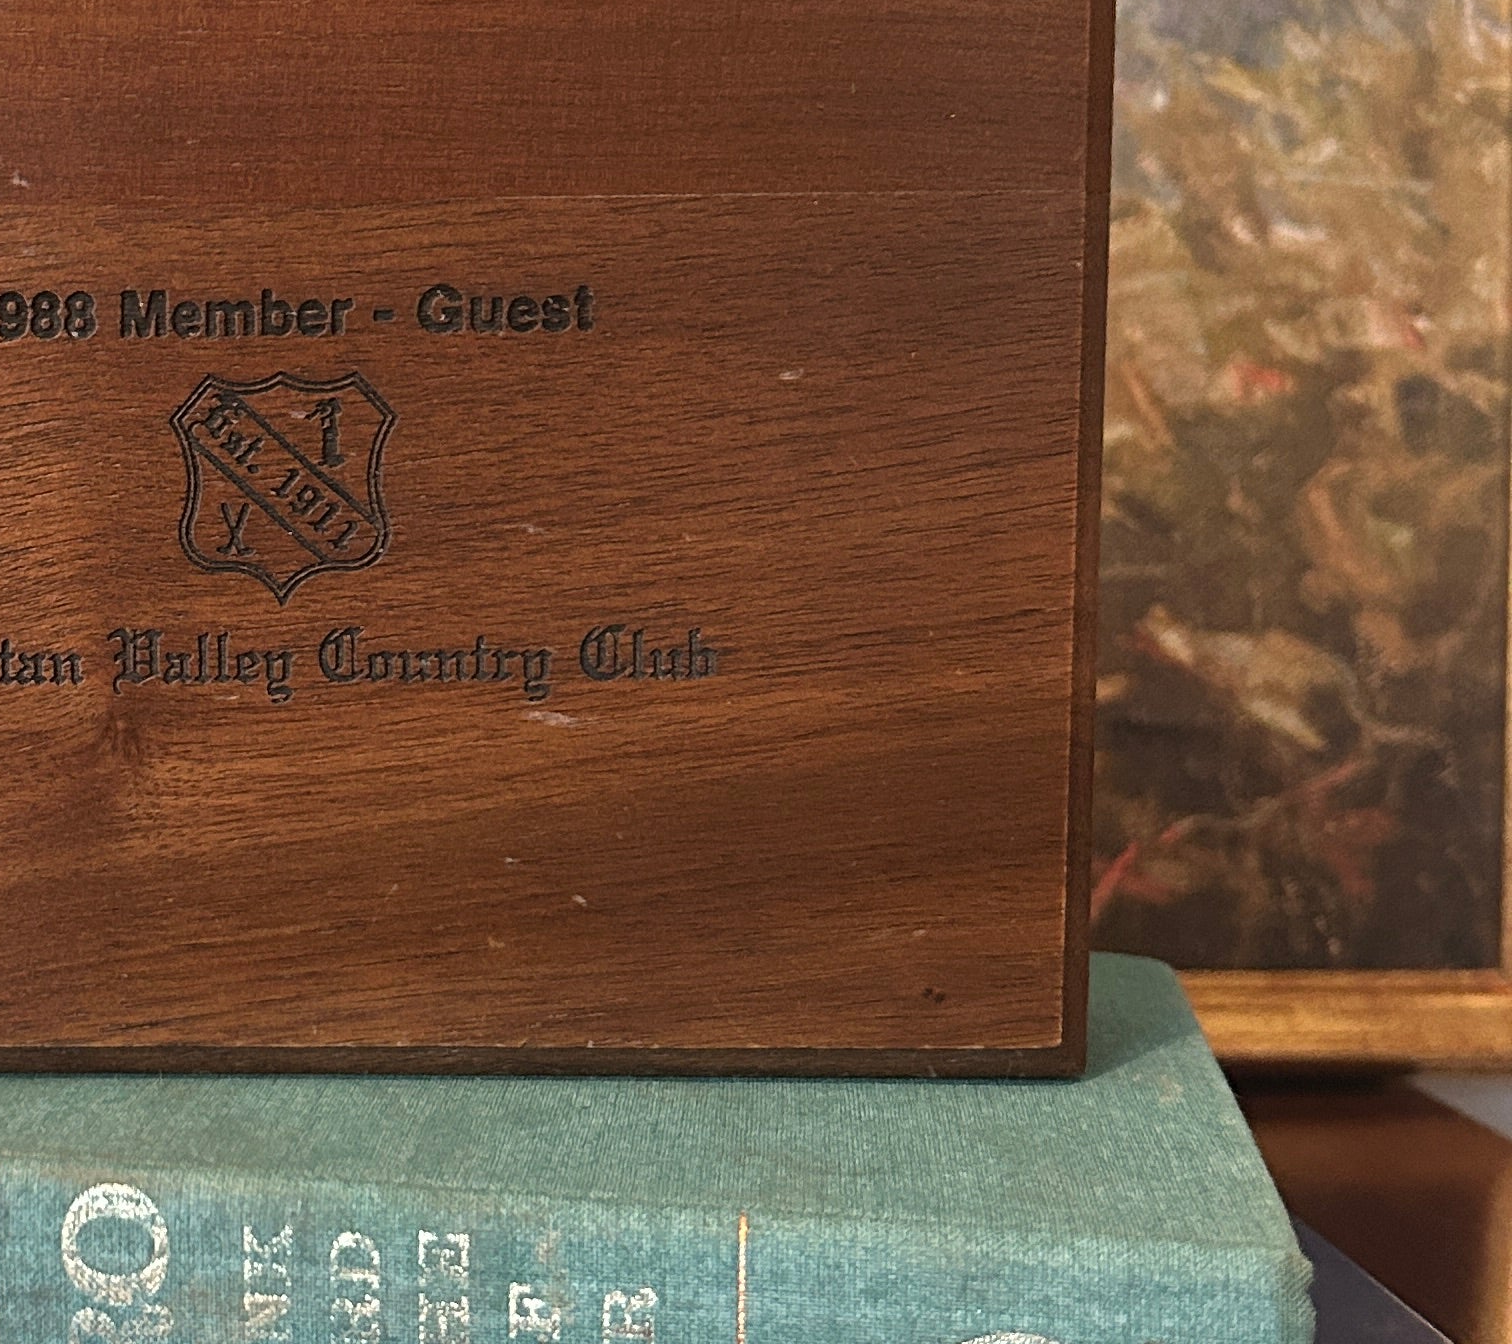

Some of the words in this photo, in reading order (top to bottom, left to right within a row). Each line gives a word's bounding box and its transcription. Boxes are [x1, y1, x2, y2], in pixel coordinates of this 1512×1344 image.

[119, 288, 354, 340] Member
[417, 283, 594, 334] Guest
[108, 627, 295, 703] Valley
[319, 627, 552, 702] Country
[579, 624, 721, 683] Club
